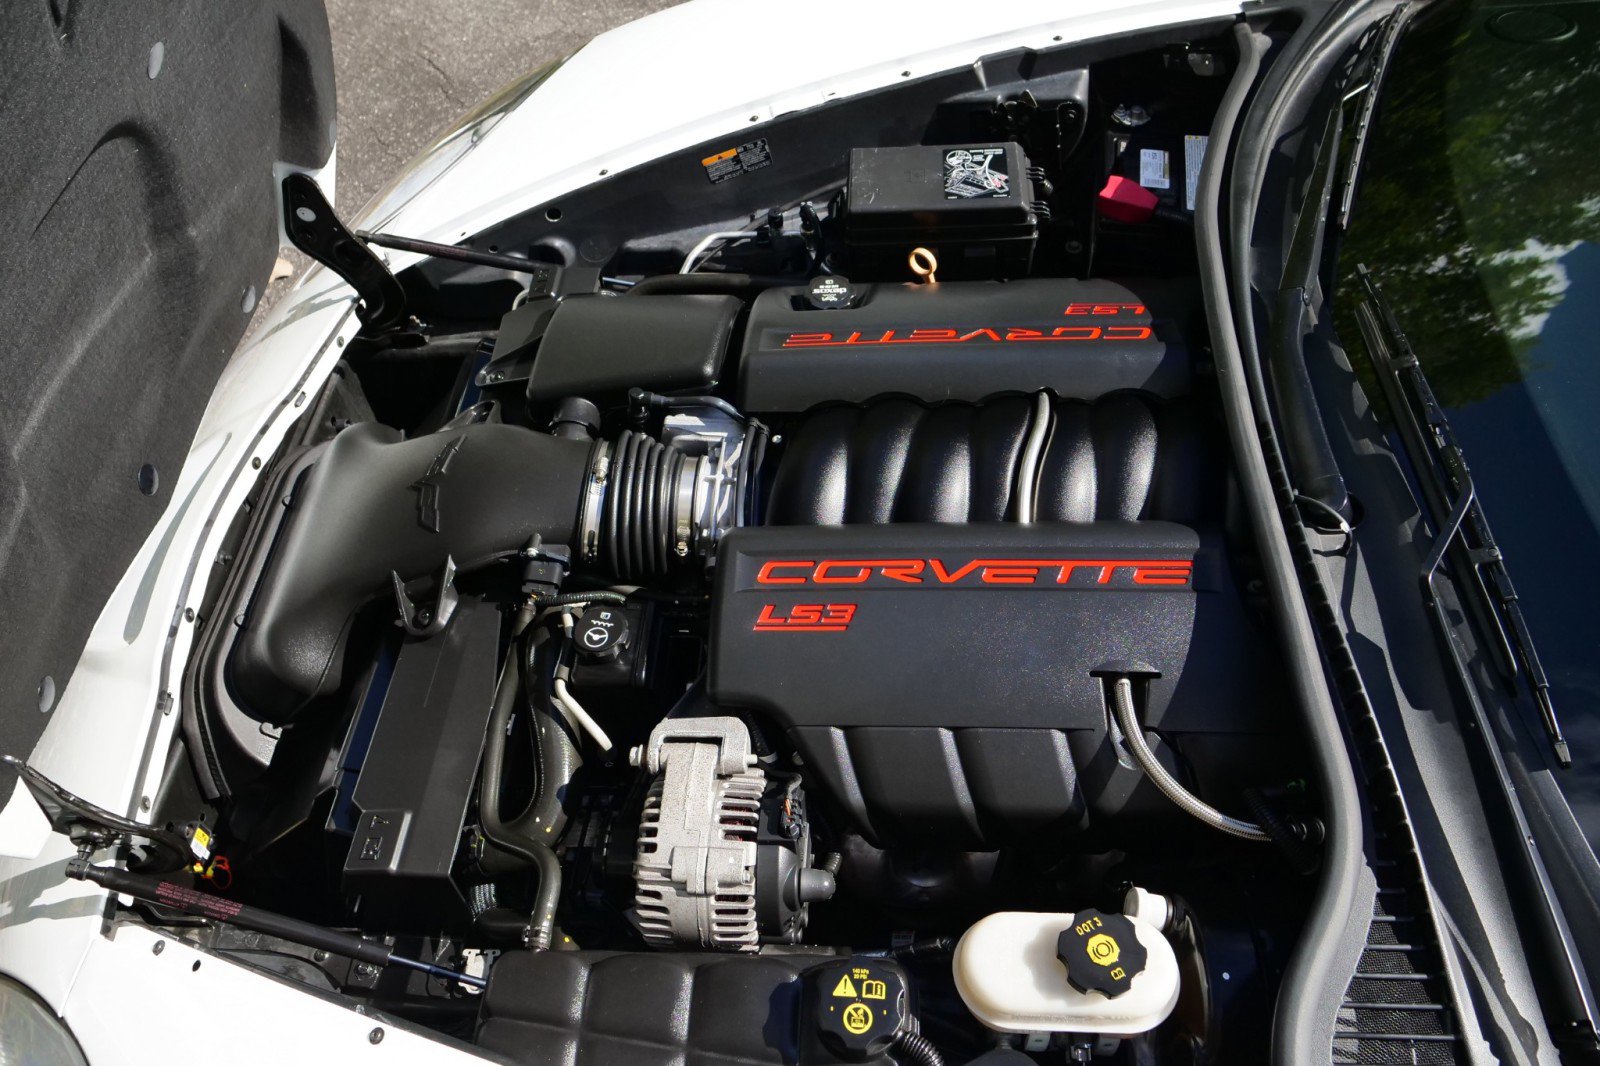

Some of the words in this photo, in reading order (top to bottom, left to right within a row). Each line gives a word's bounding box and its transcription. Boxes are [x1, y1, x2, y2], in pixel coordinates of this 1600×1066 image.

[1064, 303, 1145, 315] LS3
[784, 327, 1152, 347] CORVETTE
[757, 558, 1193, 585] CORVETTE
[754, 603, 856, 632] LS3
[1075, 919, 1095, 936] DOT
[1093, 916, 1103, 927] 3
